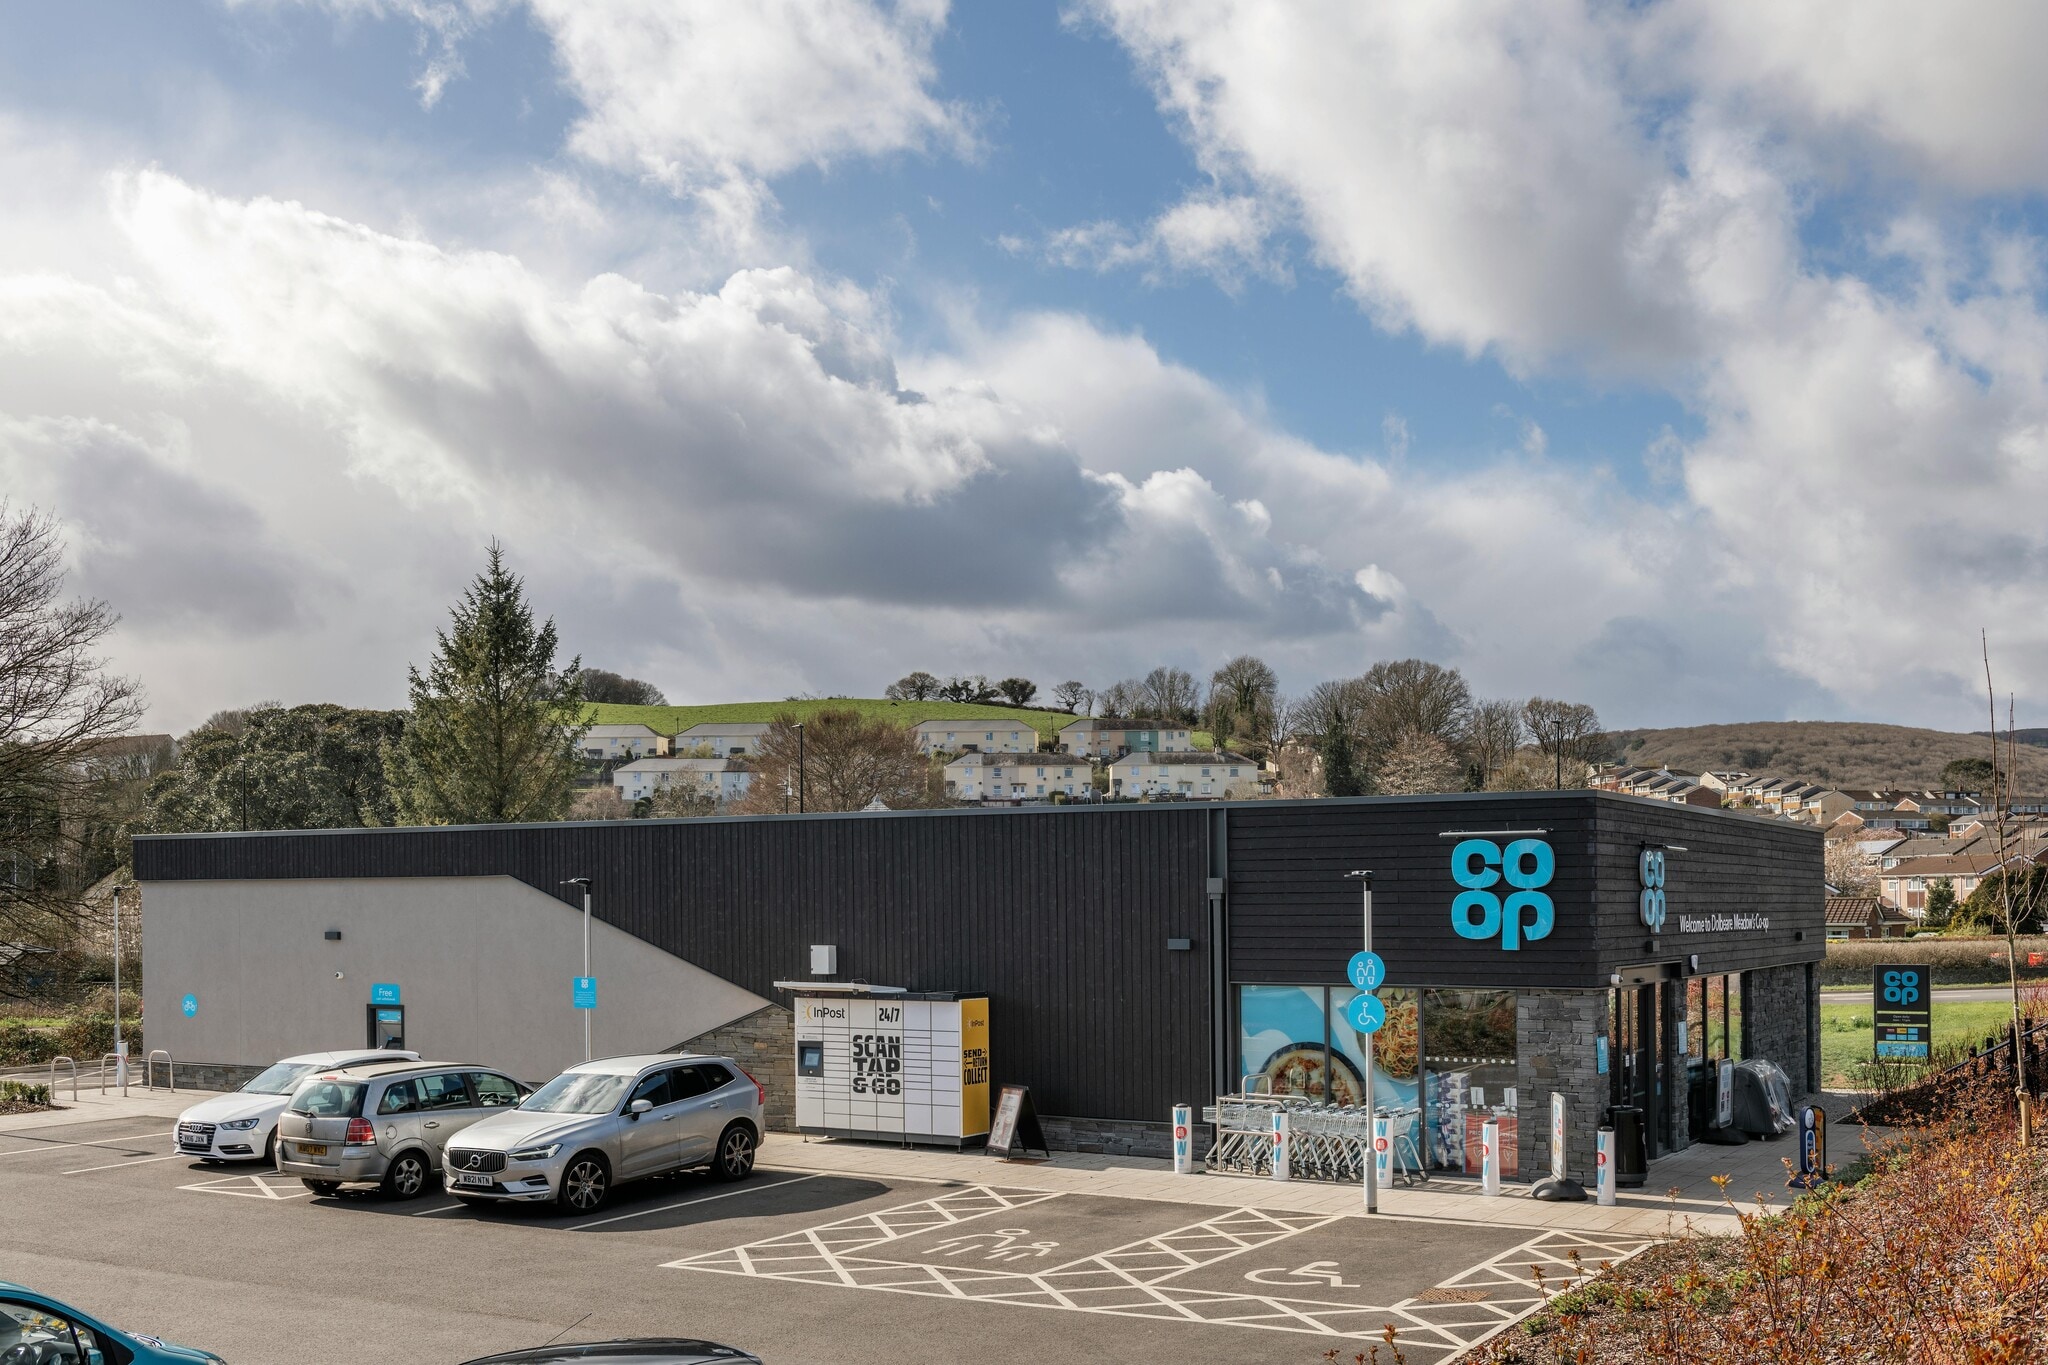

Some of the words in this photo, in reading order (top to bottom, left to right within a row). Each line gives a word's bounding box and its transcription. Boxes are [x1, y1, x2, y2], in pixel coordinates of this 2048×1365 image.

[1679, 914, 1704, 933] Welcome
[1705, 917, 1711, 932] to
[1711, 913, 1733, 932] Dolbeare
[1755, 912, 1769, 933] Co-op
[378, 988, 393, 997] Free
[813, 1007, 846, 1019] InPost
[878, 1007, 900, 1022] 24/7
[970, 1019, 985, 1027] InPost
[852, 1034, 900, 1059] SCAN
[963, 1048, 982, 1059] SEND
[852, 1058, 900, 1078] TAP
[973, 1057, 988, 1068] RETURN
[963, 1067, 988, 1086] COLLECT
[852, 1077, 868, 1094] &
[872, 1078, 901, 1096] GO
[463, 1174, 477, 1183] WB21
[477, 1176, 490, 1185] NTN
